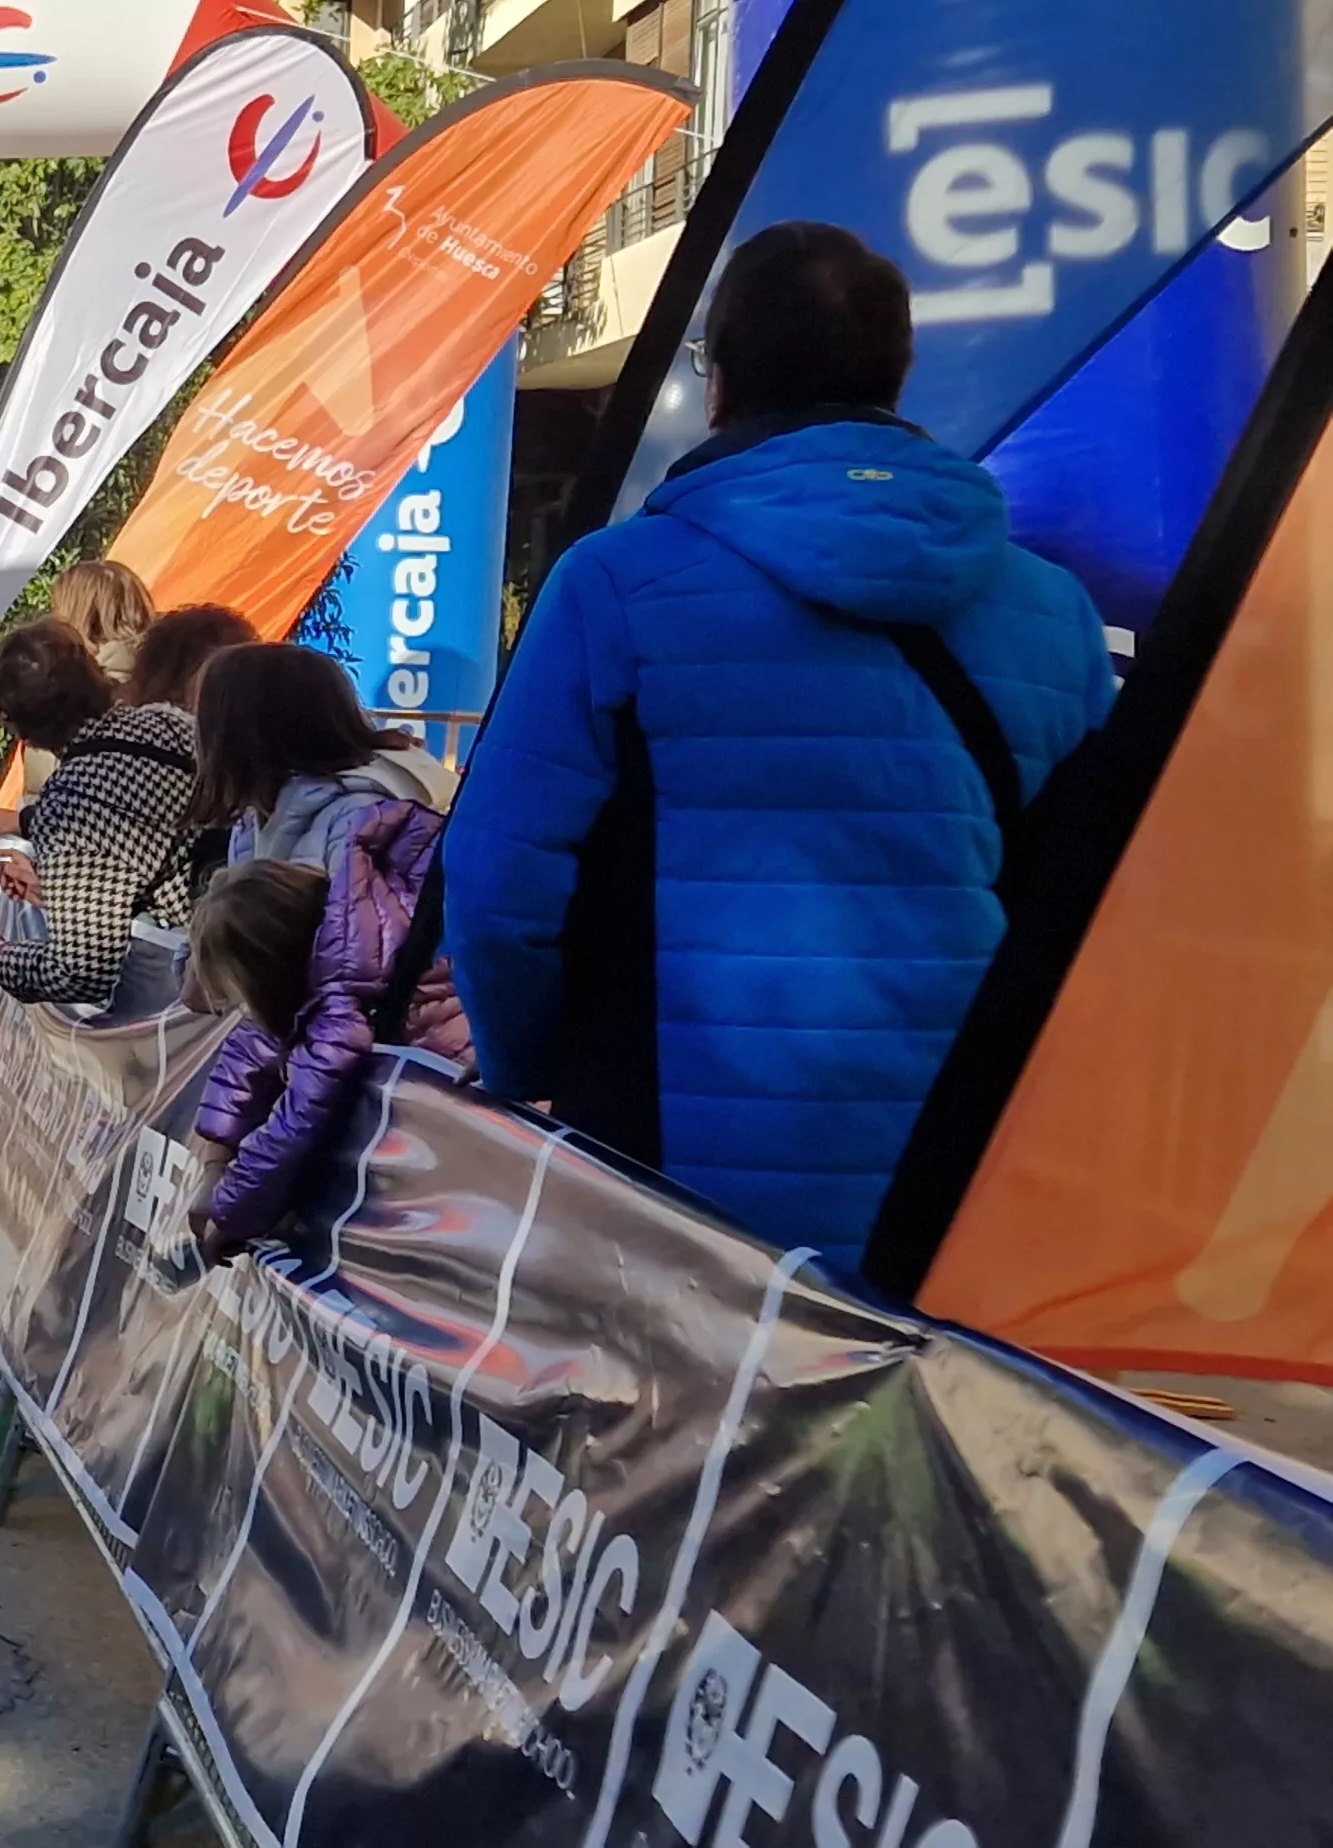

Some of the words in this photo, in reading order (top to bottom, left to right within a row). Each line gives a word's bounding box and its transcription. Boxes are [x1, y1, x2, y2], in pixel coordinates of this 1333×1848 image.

[416, 225, 439, 244] de
[438, 235, 501, 280] Huesca
[429, 204, 539, 276] Ayuntamiento
[174, 439, 339, 538] deporte
[190, 386, 376, 503] Hacemos
[330, 1308, 432, 1511] ESIC
[479, 1447, 641, 1713] ESIC
